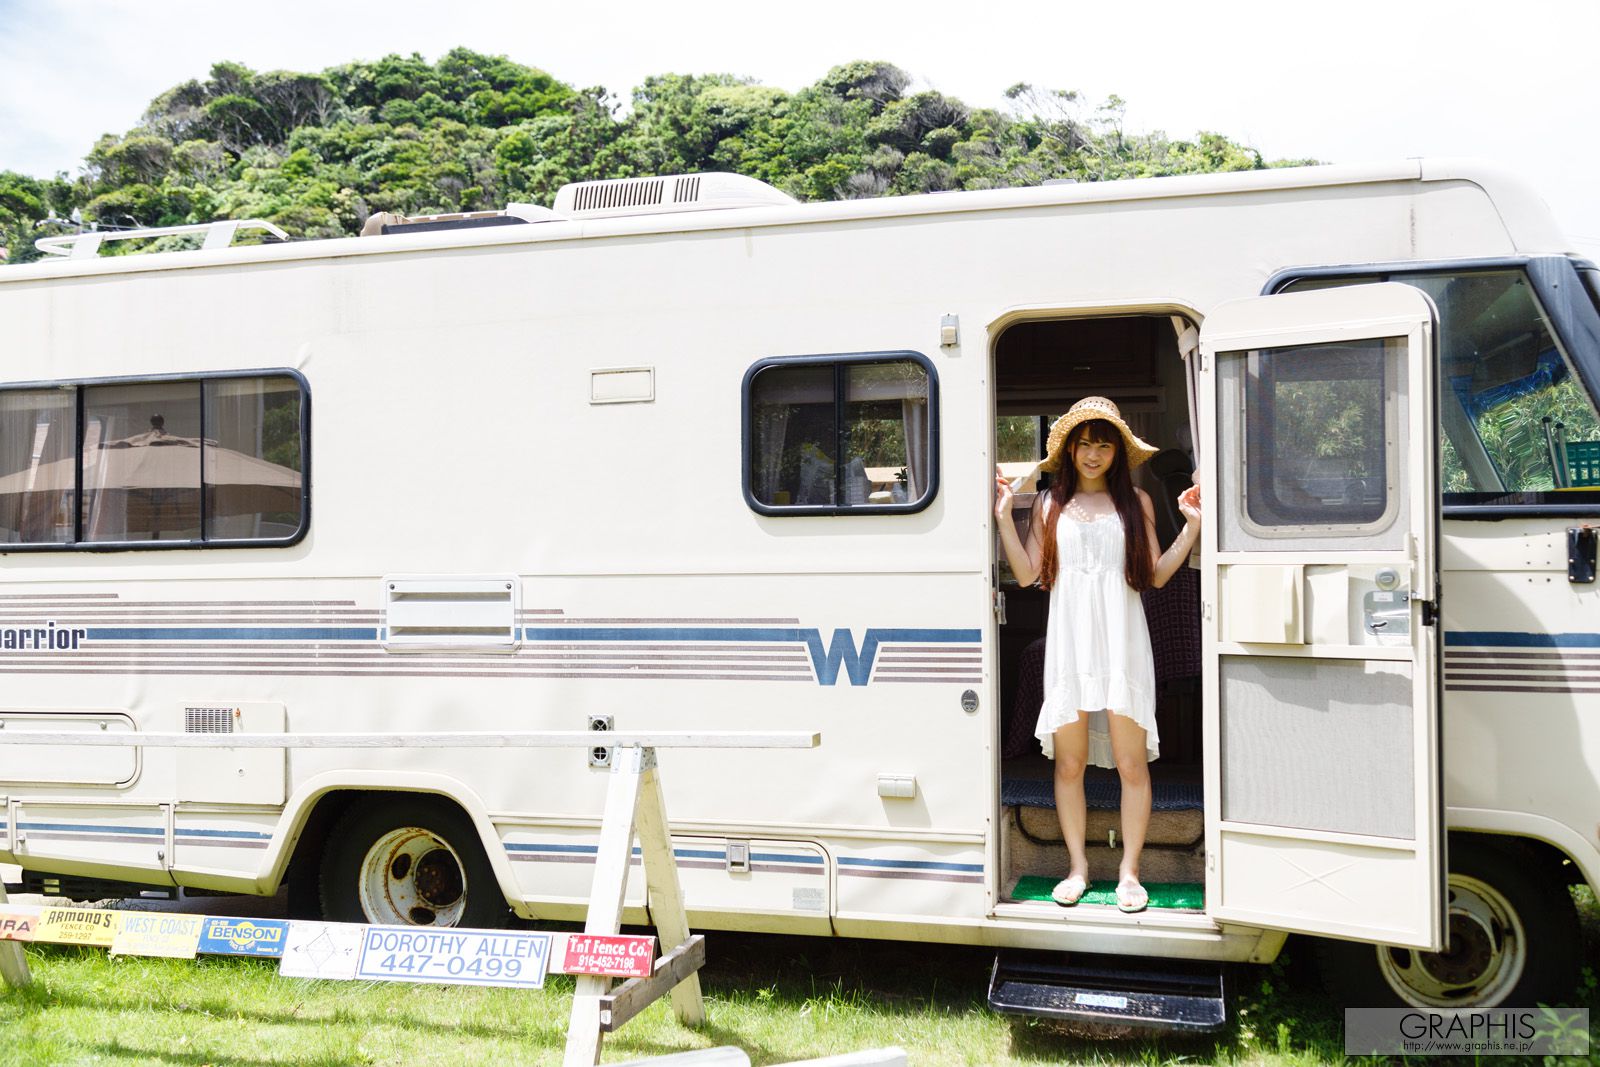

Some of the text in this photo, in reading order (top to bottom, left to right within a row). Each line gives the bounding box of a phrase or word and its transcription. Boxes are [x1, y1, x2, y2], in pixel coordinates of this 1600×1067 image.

[0, 621, 86, 650] arrior
[0, 919, 31, 932] RA
[125, 916, 198, 936] WEST COAST
[212, 926, 278, 940] BENSON
[368, 931, 544, 959] DOROTHY ALLEN
[593, 940, 626, 955] Fence
[380, 953, 523, 978] 447-0499
